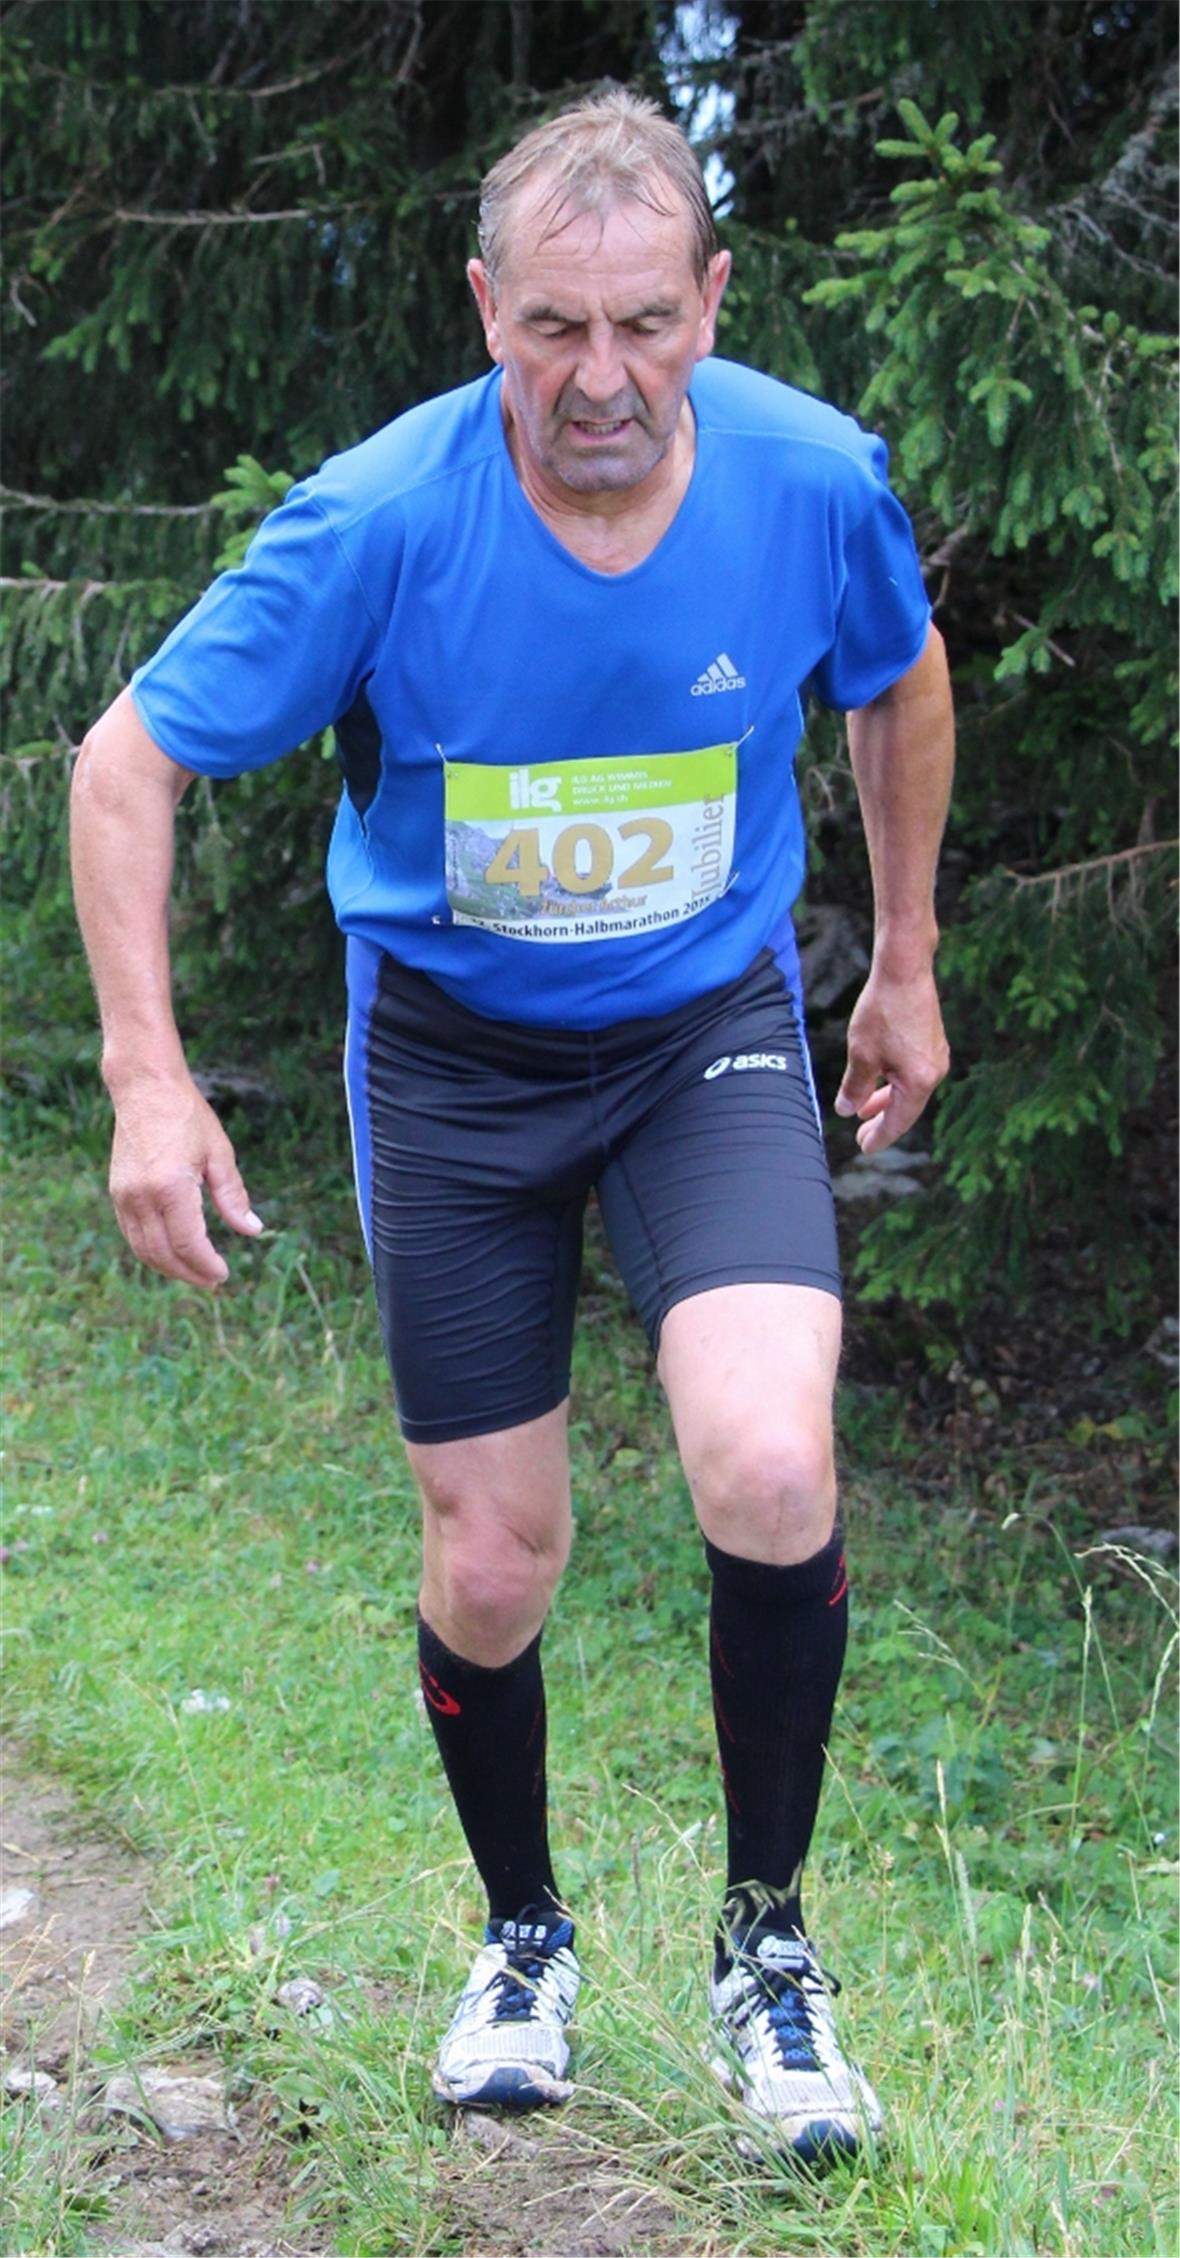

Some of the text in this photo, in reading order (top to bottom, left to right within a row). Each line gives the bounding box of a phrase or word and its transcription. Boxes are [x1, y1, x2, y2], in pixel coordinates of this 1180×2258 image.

[690, 676, 746, 696] adidas
[509, 769, 562, 812] ilg
[608, 782, 631, 793] UND
[633, 779, 672, 791] MEDIEN
[485, 817, 673, 896] 402
[493, 908, 679, 937] Stockhorn-Halbmarathon
[733, 1053, 787, 1071] asics
